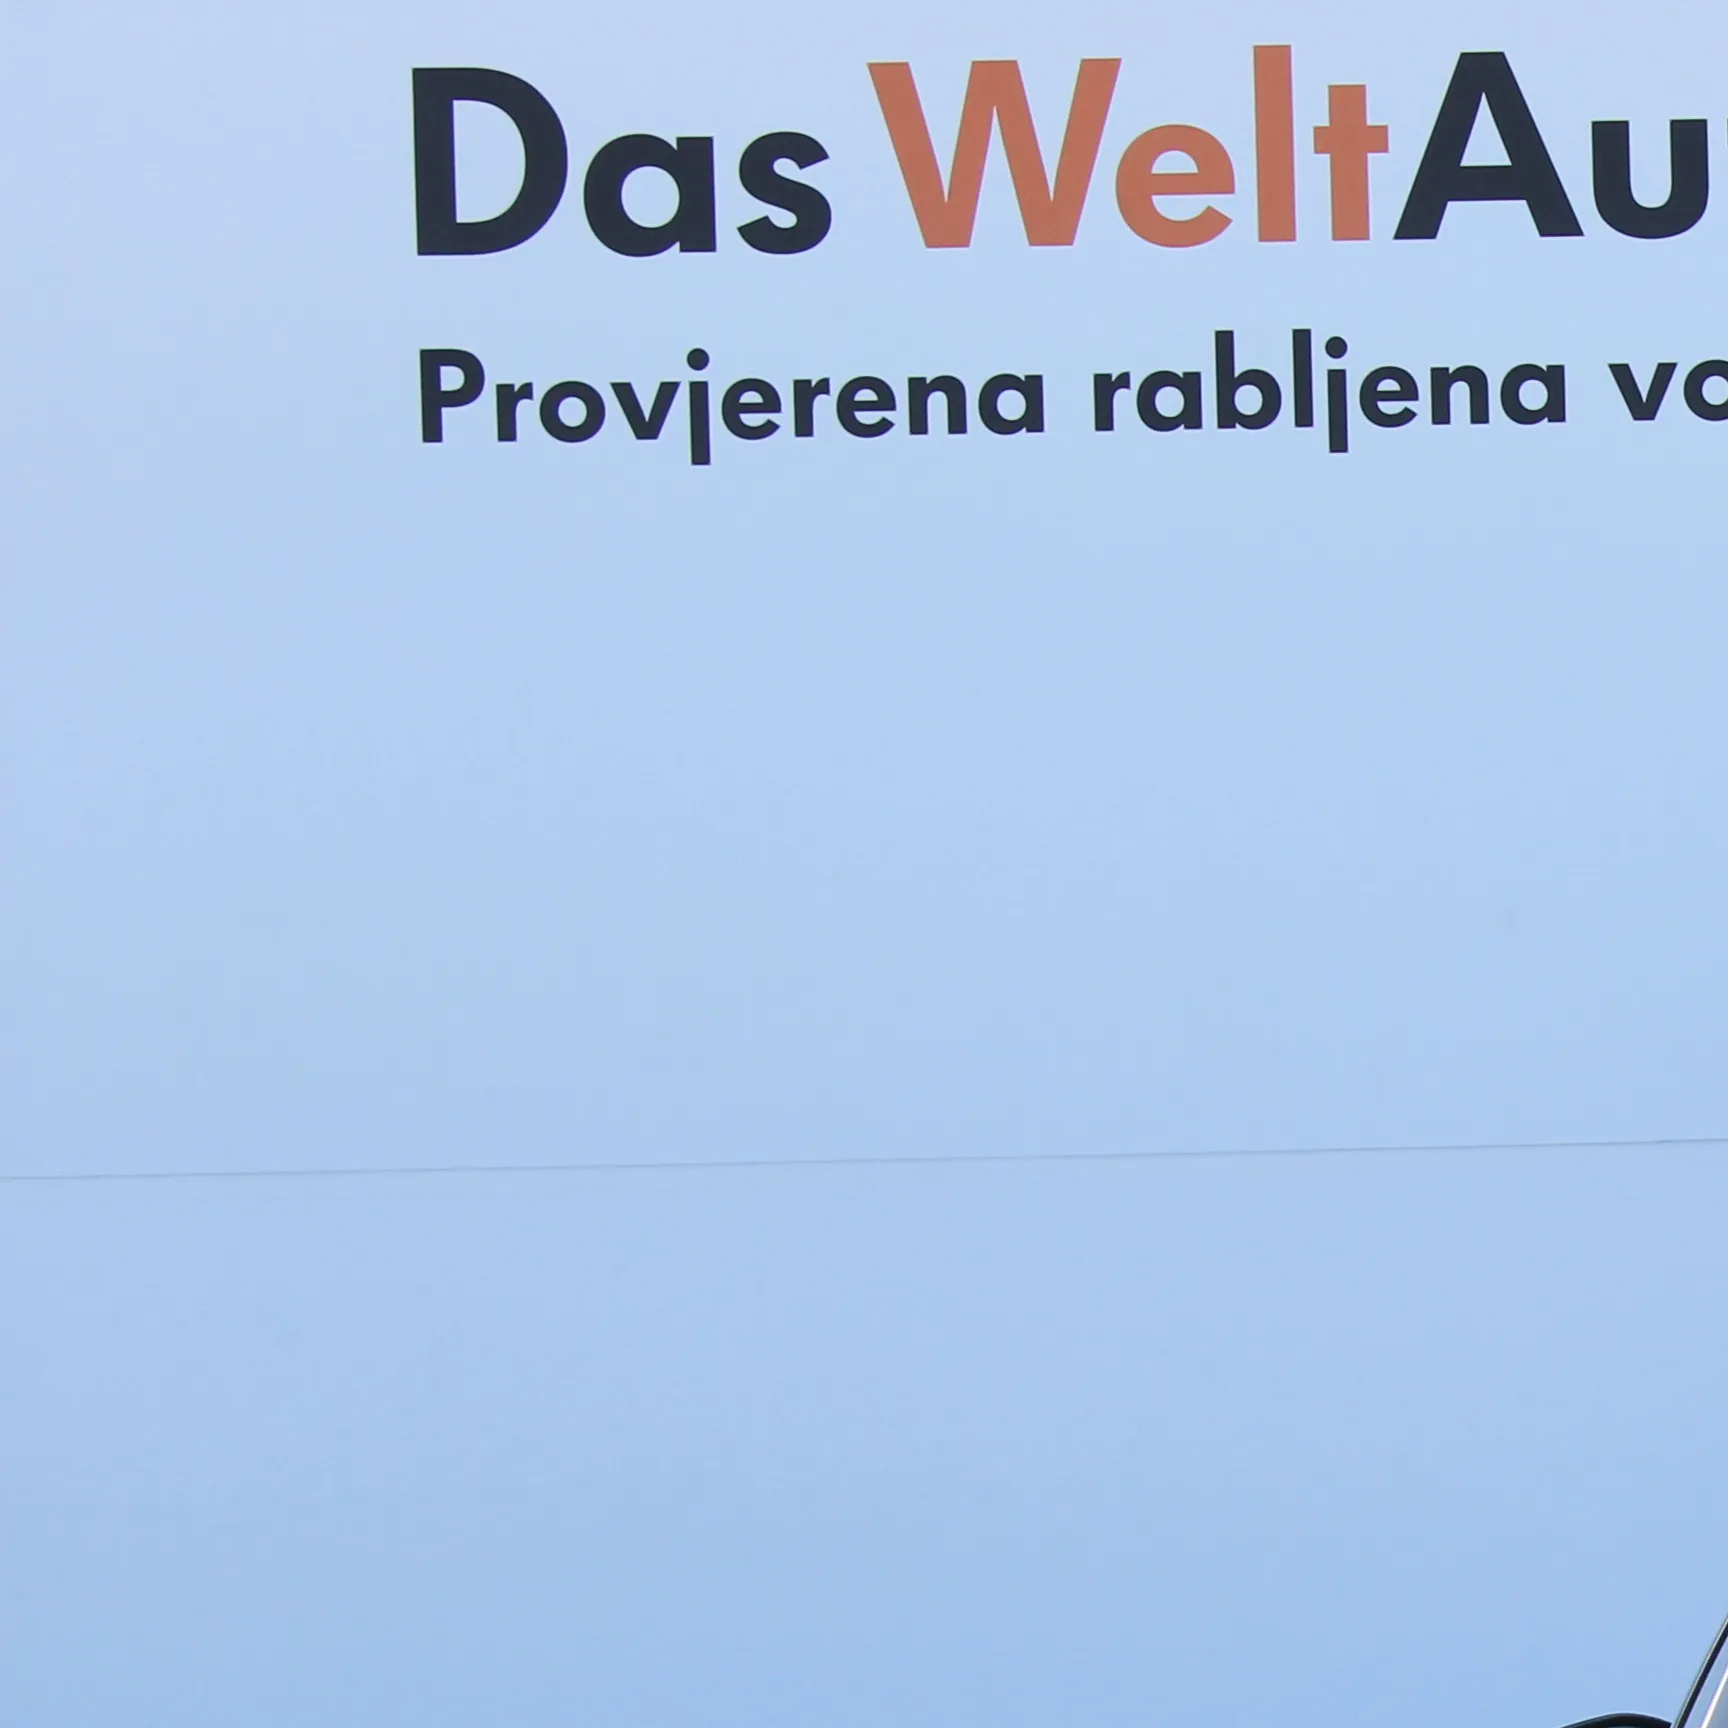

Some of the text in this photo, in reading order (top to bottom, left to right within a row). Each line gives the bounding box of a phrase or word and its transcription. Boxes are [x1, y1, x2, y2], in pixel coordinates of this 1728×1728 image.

[412, 67, 832, 258] Das
[419, 348, 1045, 466] Provjerena
[1093, 328, 1566, 454] rabljena
